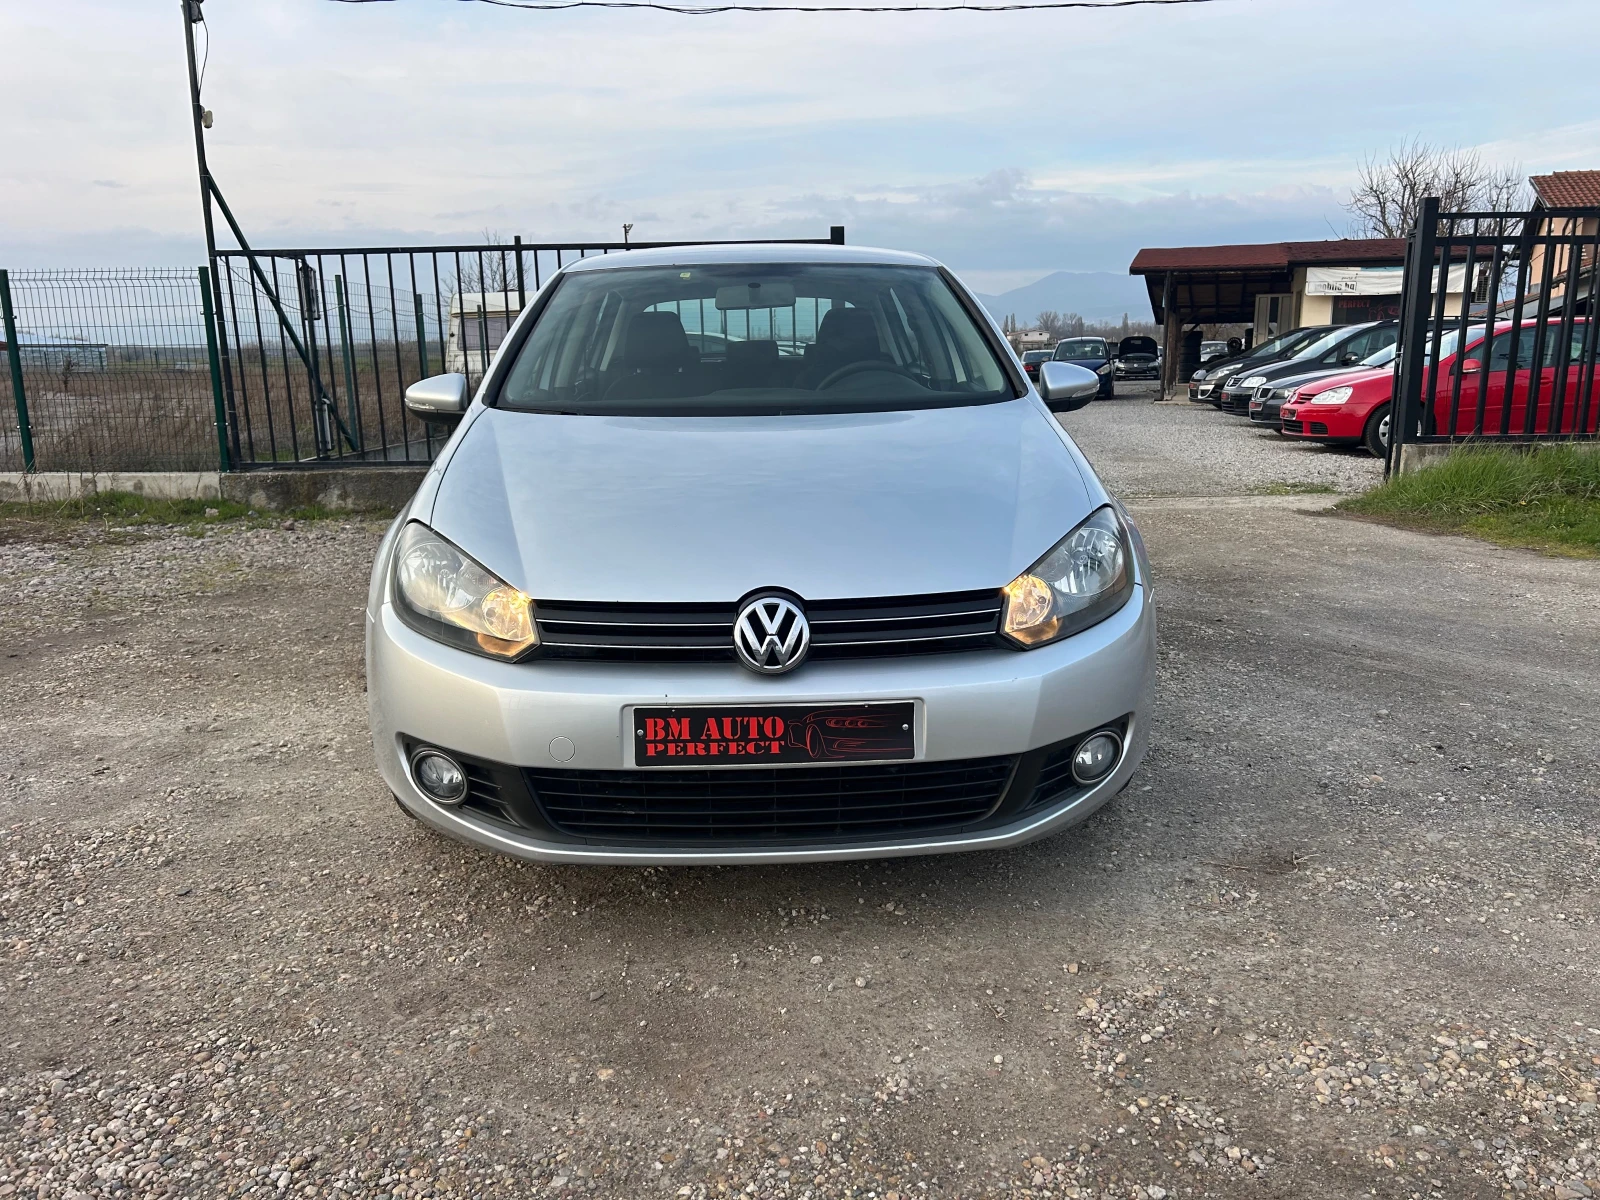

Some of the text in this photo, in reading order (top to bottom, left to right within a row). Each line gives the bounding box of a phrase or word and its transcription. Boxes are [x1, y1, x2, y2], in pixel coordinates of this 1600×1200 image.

[1338, 300, 1370, 308] PERFECT
[645, 716, 785, 740] BM AUTO
[645, 740, 785, 757] PERFECT
